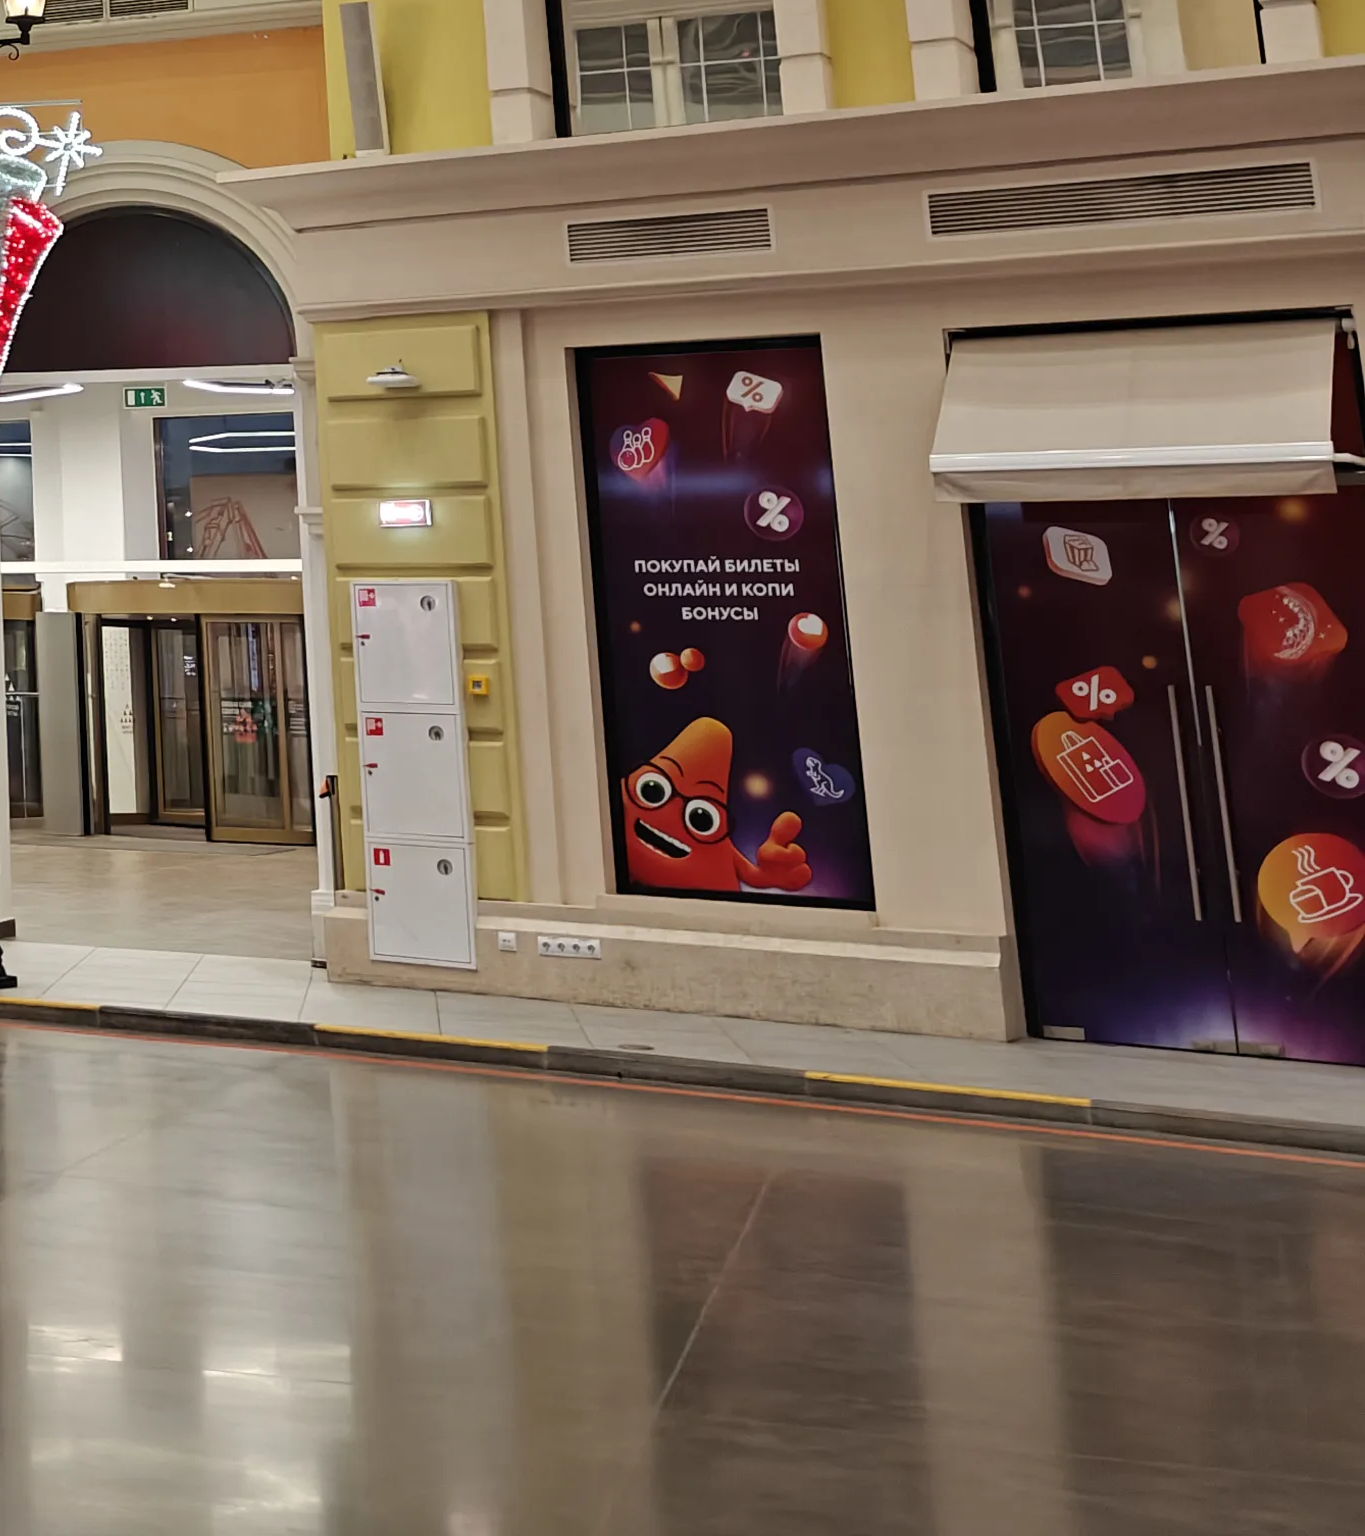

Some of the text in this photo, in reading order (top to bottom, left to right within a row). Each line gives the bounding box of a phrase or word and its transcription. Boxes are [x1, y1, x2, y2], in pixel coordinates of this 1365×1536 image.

[634, 556, 801, 573] ПОКУПАЙ БИЛЕТЫ
[643, 579, 795, 597] ОНЛАЙН И КОПИ
[681, 606, 759, 621] БОНУСЫ
